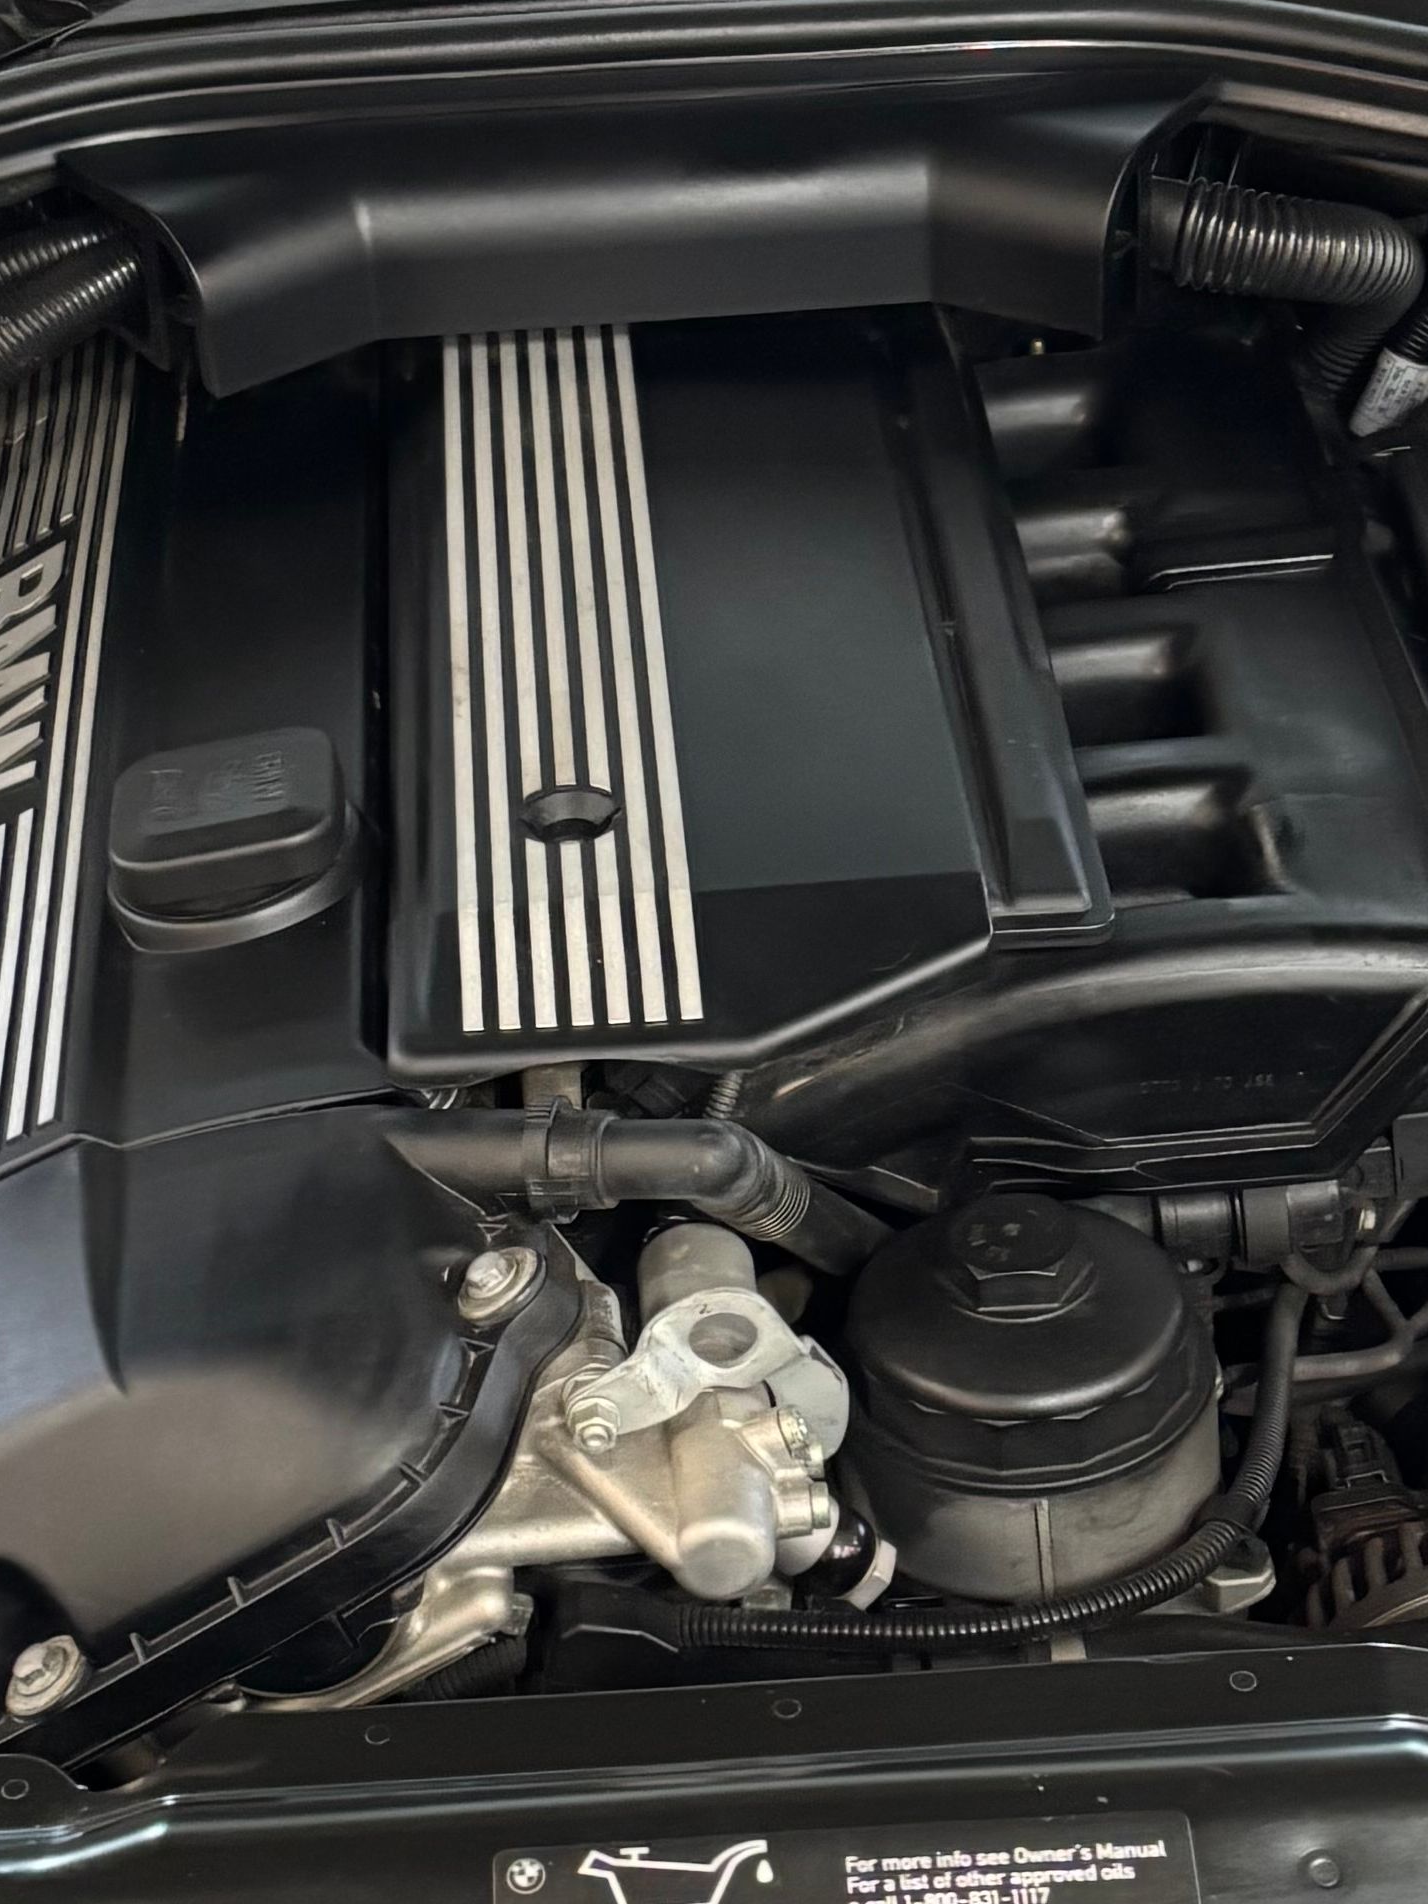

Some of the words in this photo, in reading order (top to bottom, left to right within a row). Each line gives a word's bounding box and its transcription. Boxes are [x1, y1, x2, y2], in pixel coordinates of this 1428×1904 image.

[845, 1855, 879, 1873] For
[882, 1857, 931, 1871] more
[936, 1852, 972, 1868] info
[976, 1851, 1010, 1865] see
[1014, 1845, 1092, 1864] Owner's
[1096, 1840, 1167, 1859] Manual
[847, 1876, 880, 1894] For
[883, 1878, 896, 1892] a
[900, 1874, 929, 1890] list
[933, 1872, 952, 1889] of
[955, 1870, 1006, 1887] other
[1010, 1865, 1097, 1887] approved
[1101, 1864, 1135, 1881] oils
